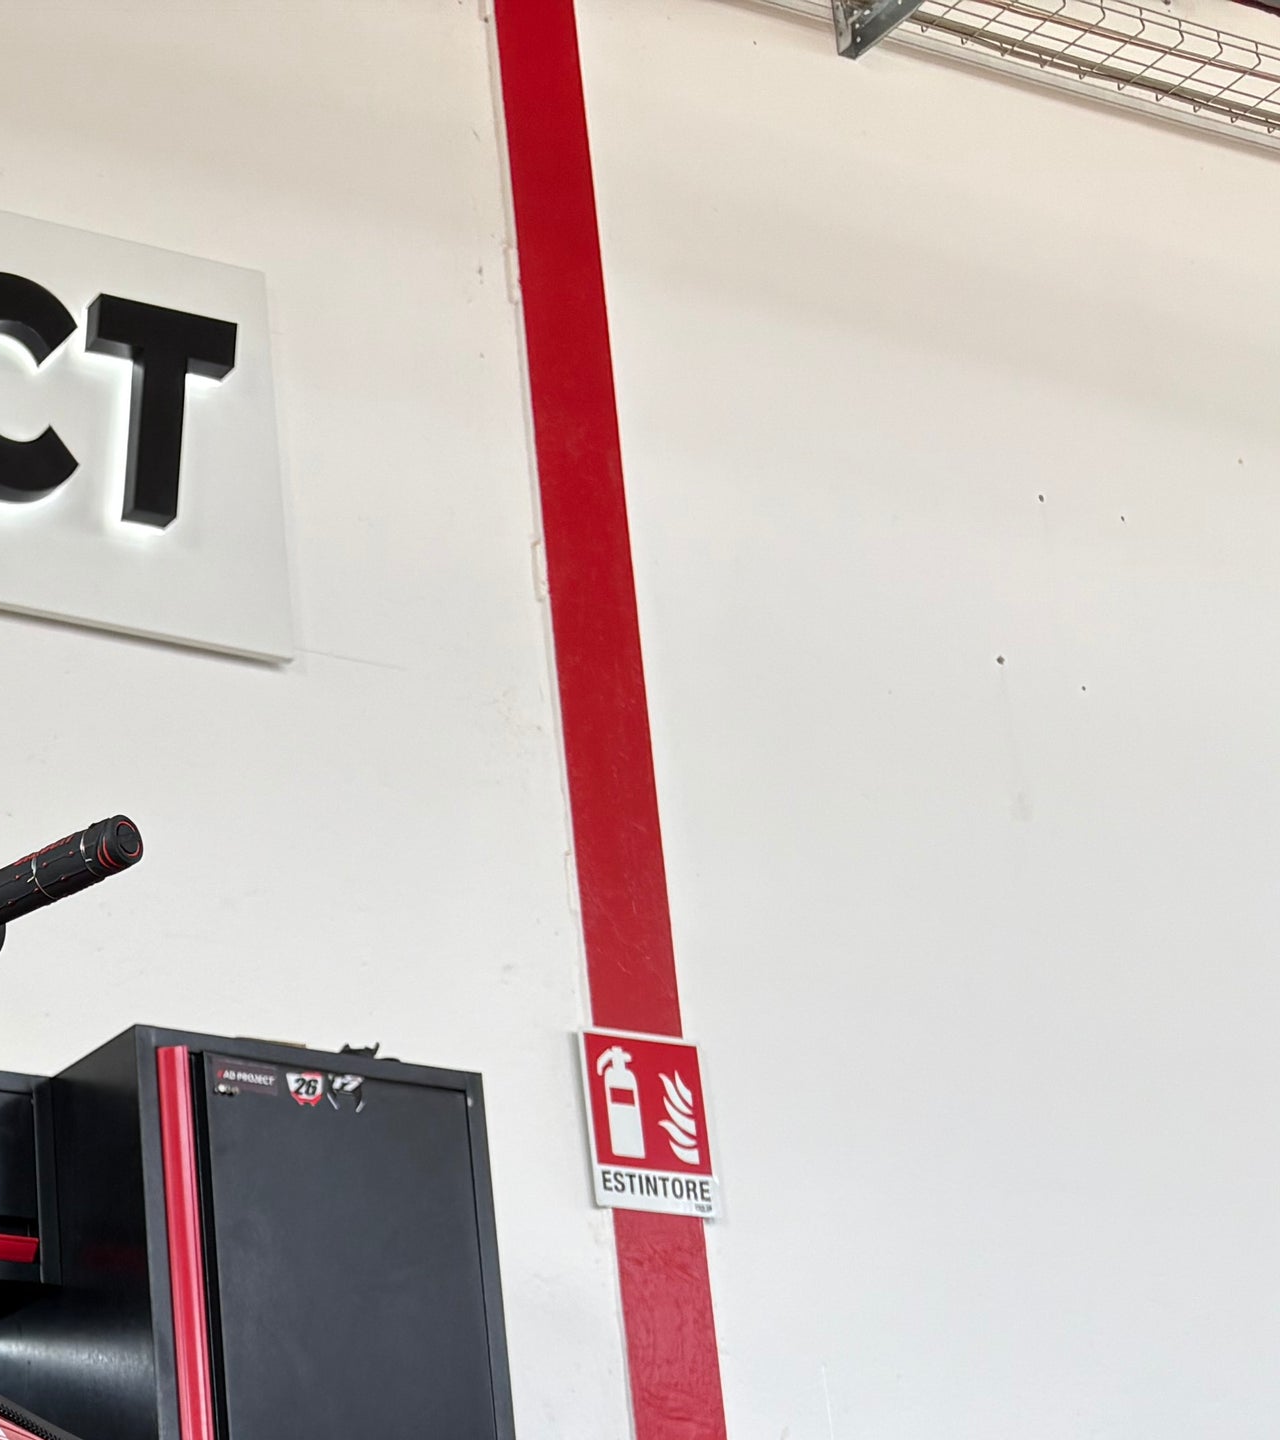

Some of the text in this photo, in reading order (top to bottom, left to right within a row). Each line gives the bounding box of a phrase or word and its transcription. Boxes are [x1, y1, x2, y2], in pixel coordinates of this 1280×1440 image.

[237, 1071, 276, 1086] PROJECT
[294, 1077, 318, 1097] 26
[601, 1169, 712, 1203] ESTINTORE
